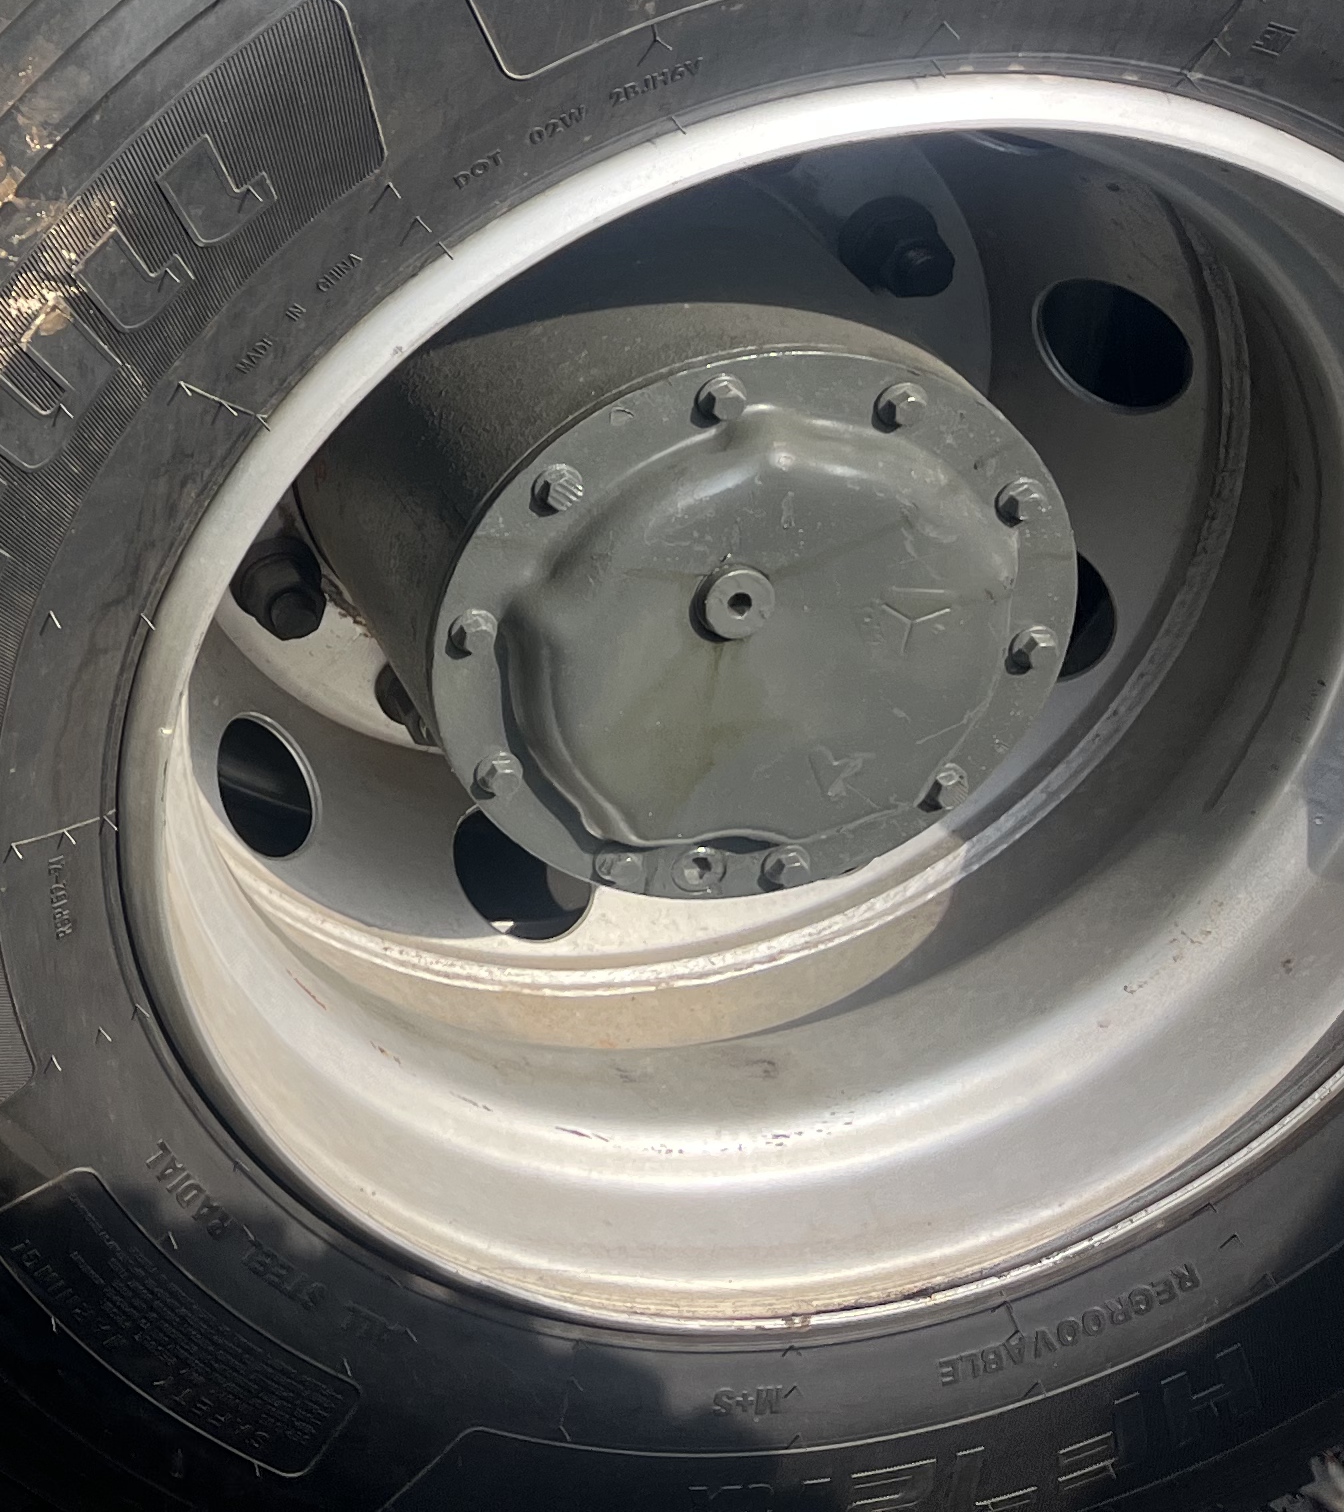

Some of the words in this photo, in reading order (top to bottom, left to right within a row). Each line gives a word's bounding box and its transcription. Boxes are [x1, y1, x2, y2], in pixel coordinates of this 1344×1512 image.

[453, 149, 506, 191] DOT
[286, 302, 308, 323] IN
[315, 253, 364, 295] CHINA
[145, 1137, 231, 1239] RADIAL
[938, 1261, 1203, 1387] REGROOVABLE
[711, 1384, 785, 1417] M+S
